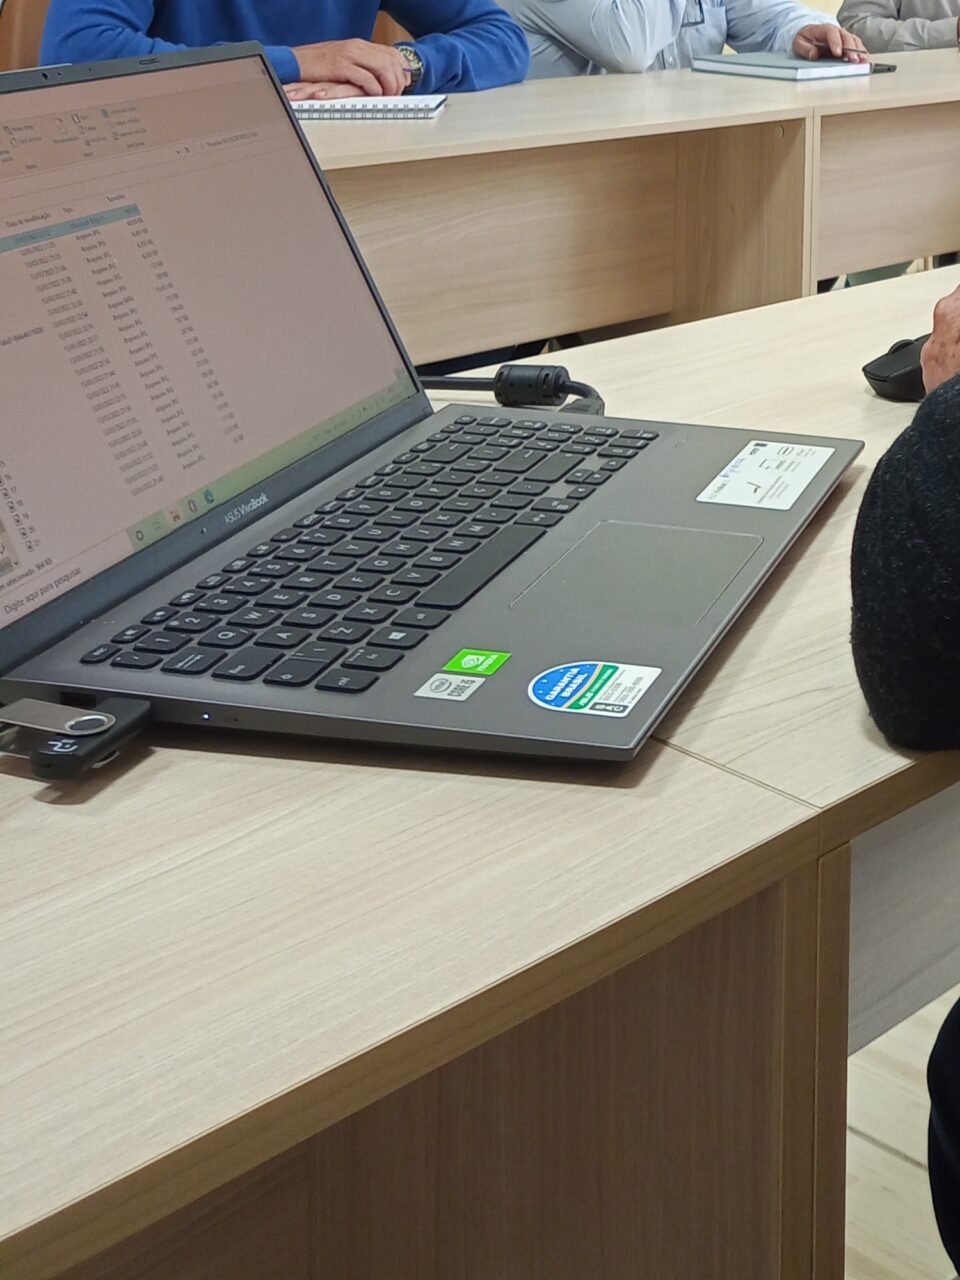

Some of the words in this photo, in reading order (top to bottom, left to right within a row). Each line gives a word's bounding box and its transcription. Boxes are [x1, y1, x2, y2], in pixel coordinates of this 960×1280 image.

[224, 508, 241, 525] ASUS
[244, 611, 263, 620] W
[545, 667, 580, 701] GARANTIA
[560, 673, 588, 698] BRASIL
